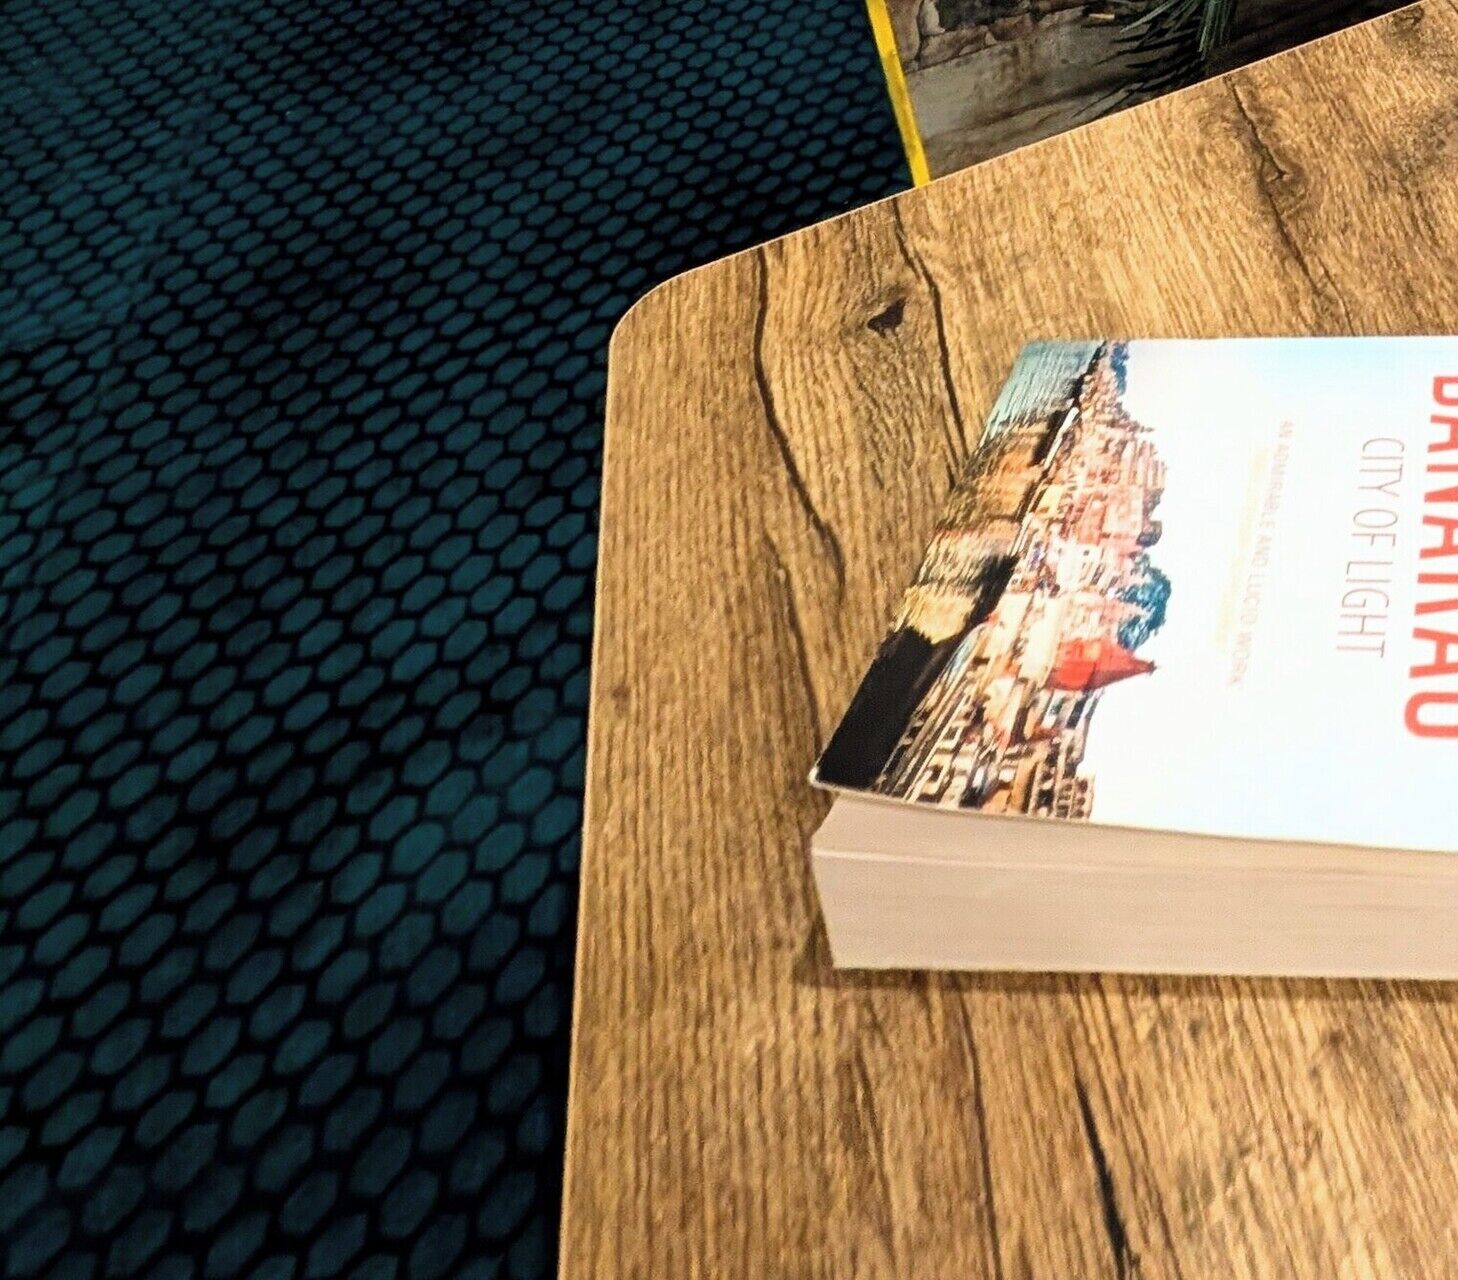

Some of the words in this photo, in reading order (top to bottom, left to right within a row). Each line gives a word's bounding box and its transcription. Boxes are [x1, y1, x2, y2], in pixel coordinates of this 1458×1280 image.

[1357, 437, 1406, 498] CITY
[1352, 508, 1399, 547] OF
[1336, 560, 1394, 658] LIGHT
